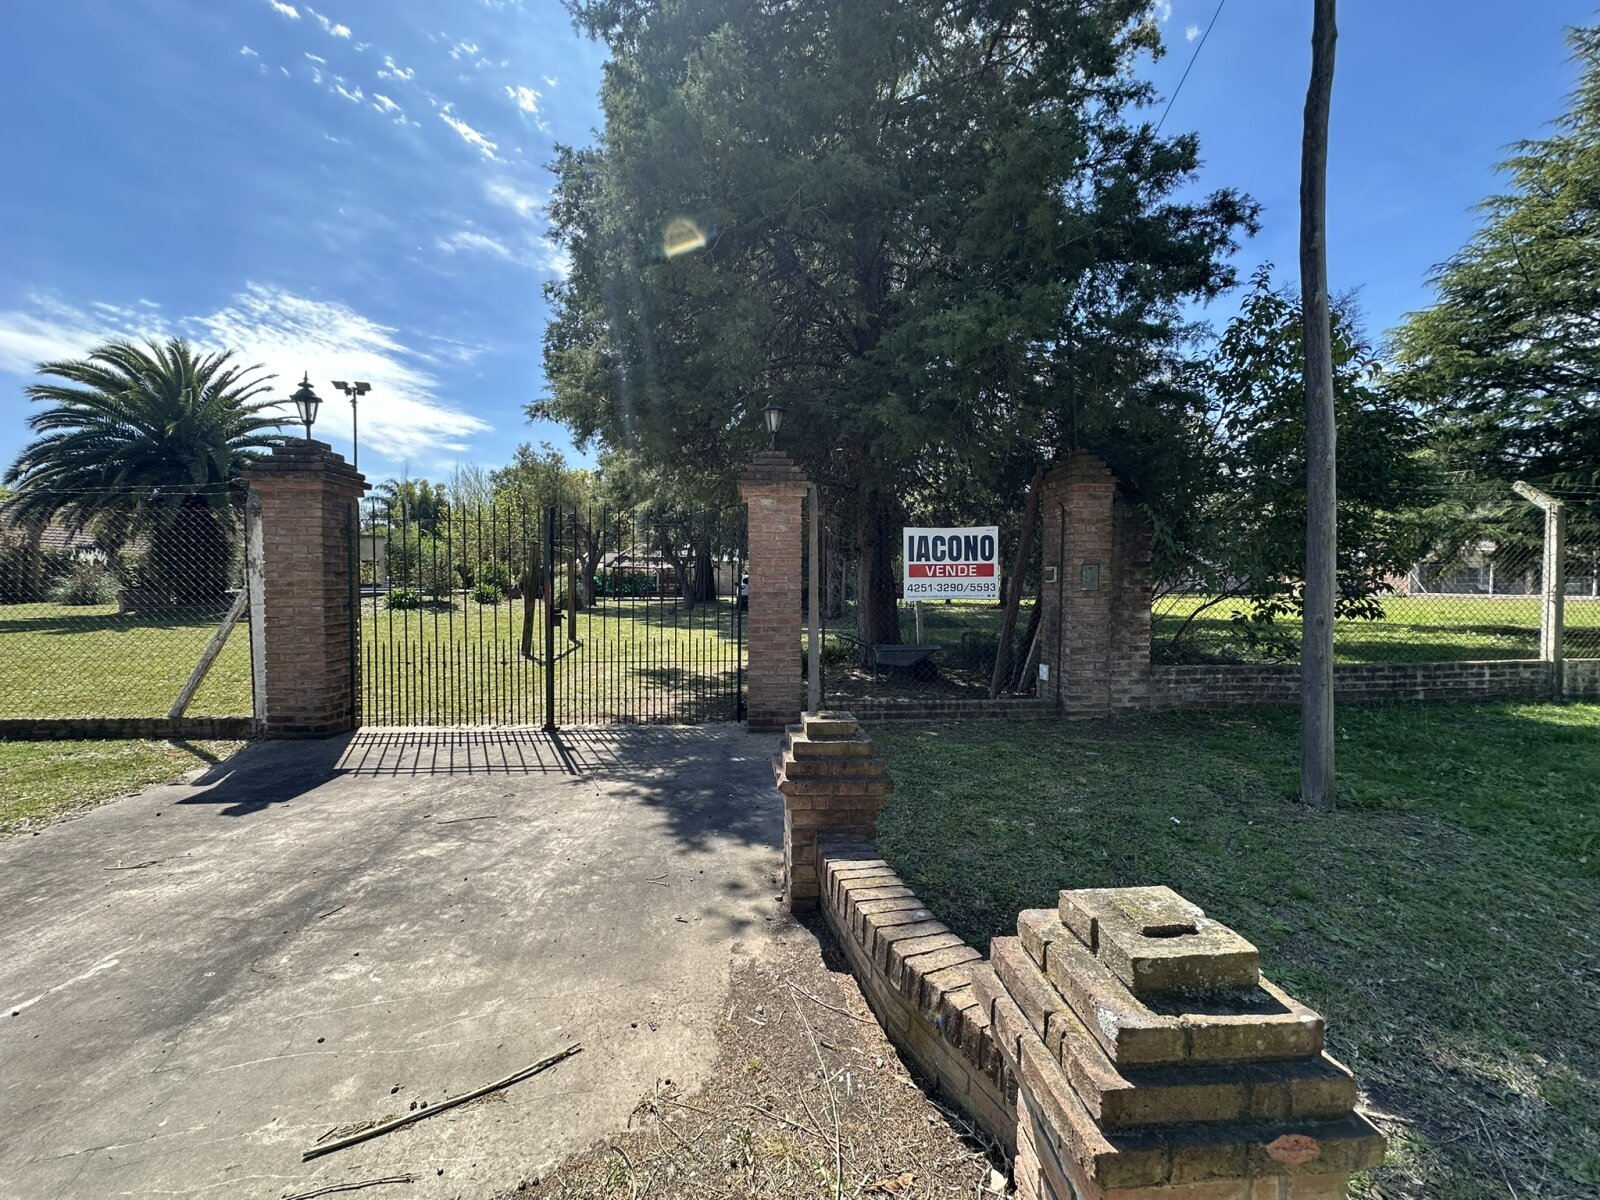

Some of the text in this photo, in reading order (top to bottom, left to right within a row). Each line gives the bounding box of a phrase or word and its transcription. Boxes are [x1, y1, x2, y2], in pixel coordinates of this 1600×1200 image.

[908, 535, 994, 562] IACONO
[925, 565, 977, 576] VENDE
[907, 583, 996, 592] 4251-3290/5593
